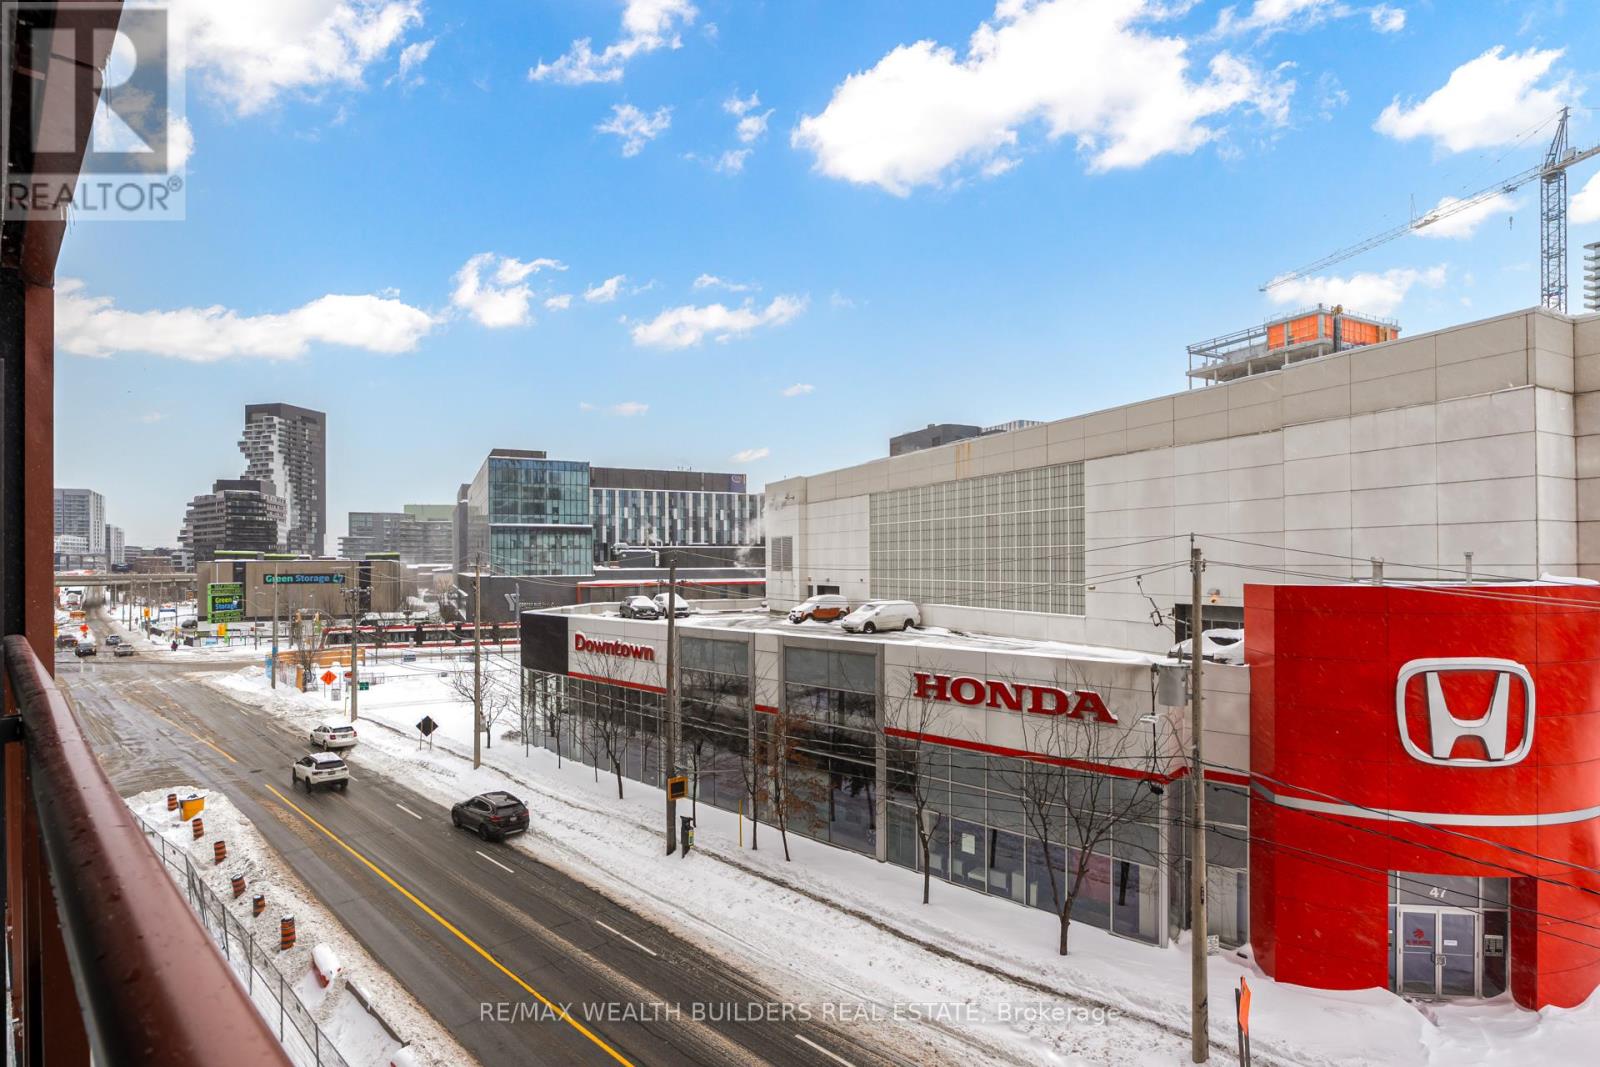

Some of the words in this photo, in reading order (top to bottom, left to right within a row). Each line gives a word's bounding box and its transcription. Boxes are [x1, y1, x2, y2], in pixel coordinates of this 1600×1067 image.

[265, 574, 293, 583] Green
[295, 574, 330, 584] Storage
[574, 632, 655, 661] Downtown
[913, 672, 1119, 724] HONDA
